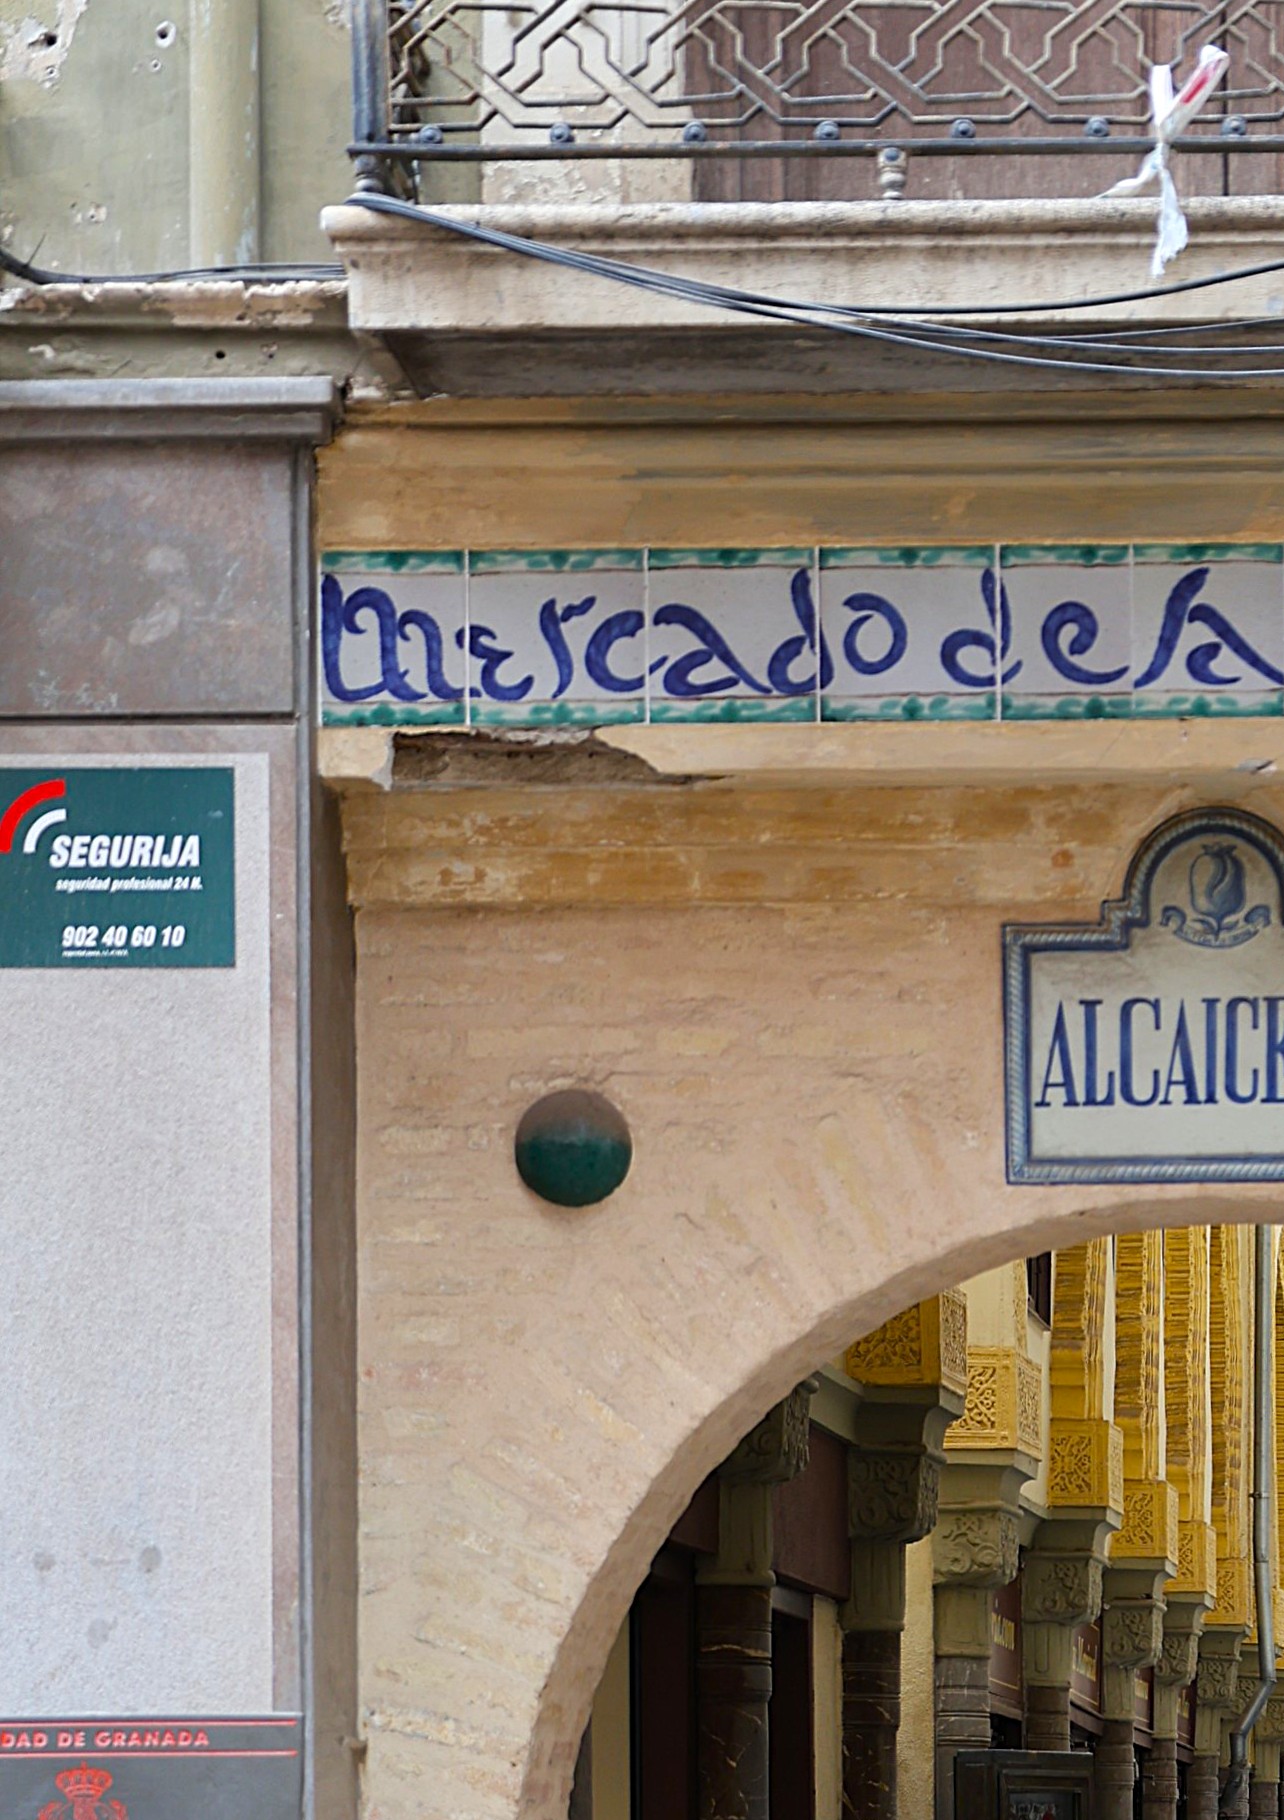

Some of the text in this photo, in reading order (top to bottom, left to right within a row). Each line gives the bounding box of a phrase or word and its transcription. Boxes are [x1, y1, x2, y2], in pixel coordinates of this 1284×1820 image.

[49, 834, 201, 869] SEGURIJA
[55, 876, 111, 894] seguridad
[173, 876, 190, 890] 24
[61, 925, 186, 948] 902 40 60 10
[57, 1731, 87, 1748] DE
[94, 1730, 210, 1748] GRANADA
